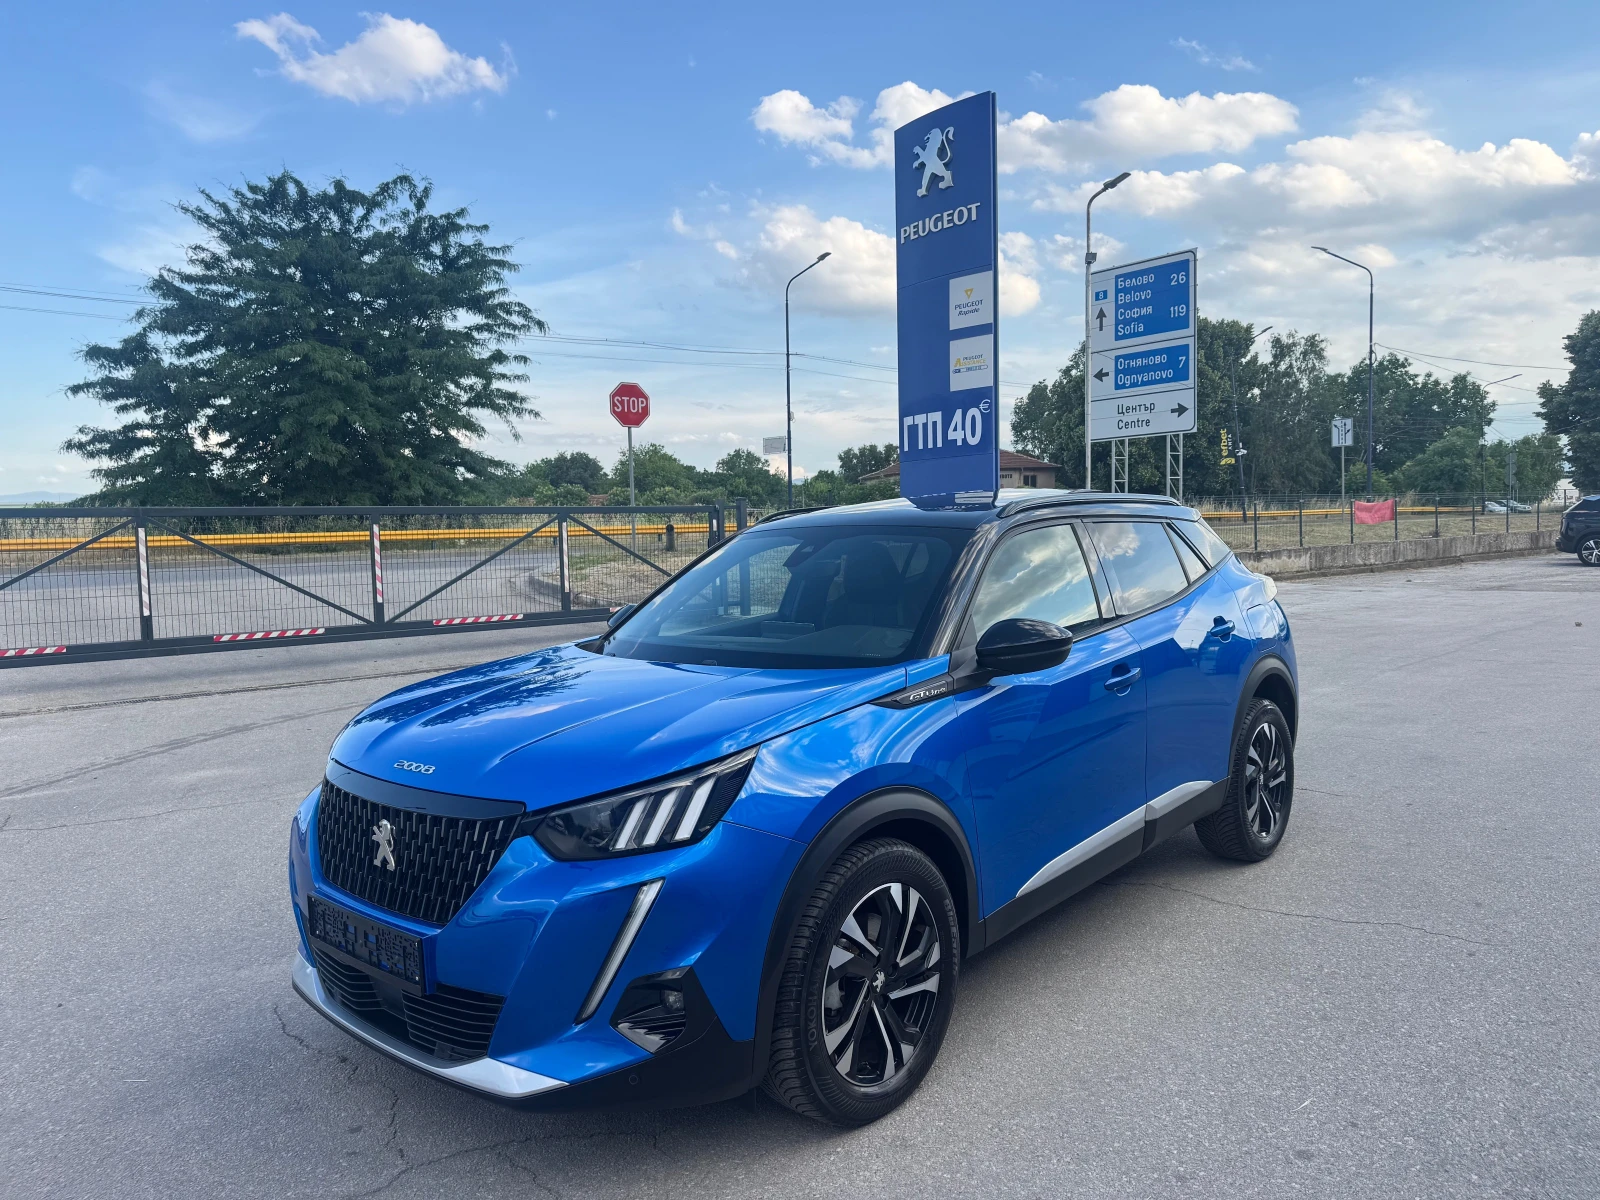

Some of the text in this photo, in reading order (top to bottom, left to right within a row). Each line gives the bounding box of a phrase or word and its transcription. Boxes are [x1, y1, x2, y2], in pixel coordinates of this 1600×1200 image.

[900, 202, 981, 244] PEUGEOT
[1117, 271, 1187, 289] Белово 26
[1098, 291, 1104, 300] 8
[1117, 289, 1152, 305] Belovo
[954, 298, 984, 311] PEUGEOT
[957, 307, 981, 317] Rapide
[1117, 304, 1187, 320] София 119
[1117, 322, 1144, 336] Sofia
[962, 353, 984, 361] PEUGEOT
[1117, 354, 1187, 370] Огняново 7
[1117, 368, 1174, 386] Ognyanovo
[613, 396, 647, 413] STOP
[1117, 402, 1156, 417] Център
[903, 410, 943, 452] ГТП
[1117, 417, 1151, 430] Centre
[1220, 428, 1229, 456] efbet
[393, 759, 436, 775] 2008
